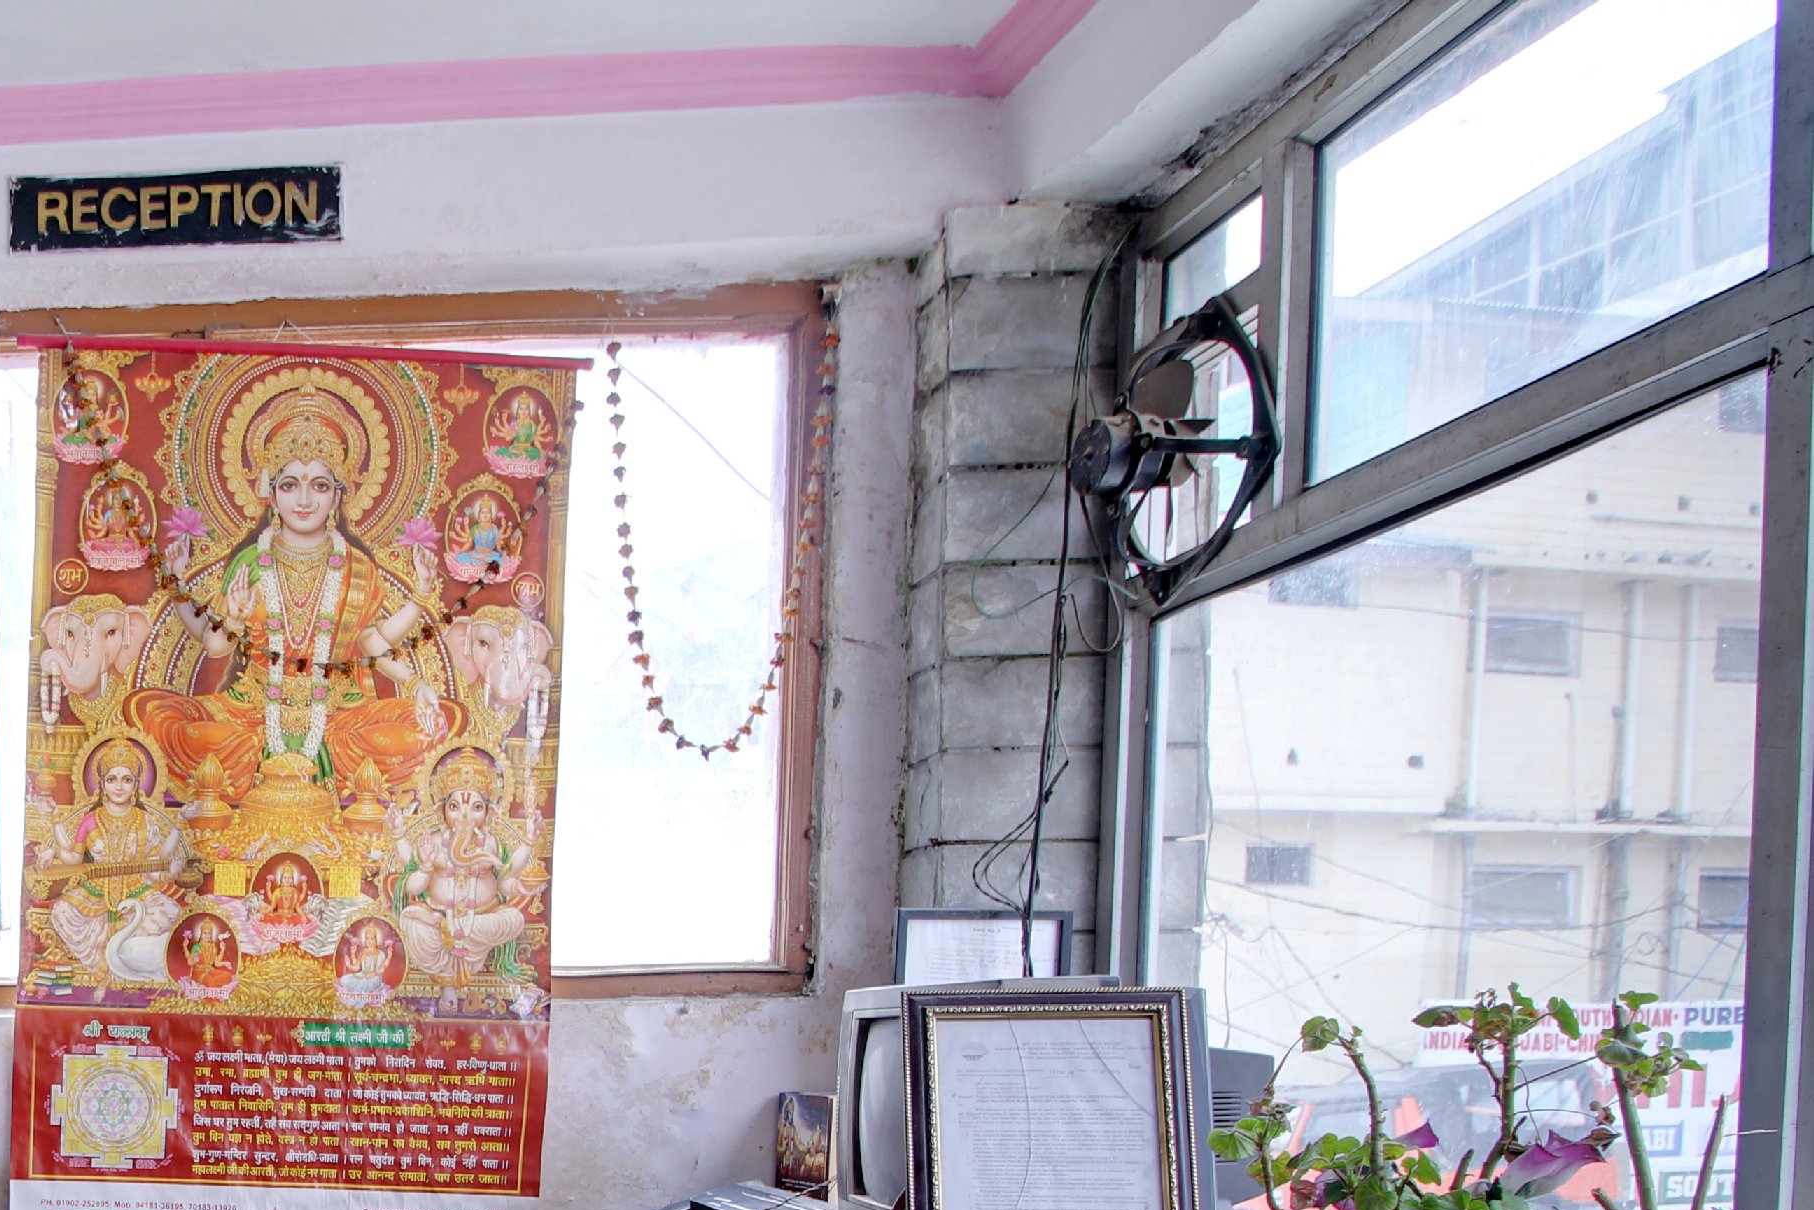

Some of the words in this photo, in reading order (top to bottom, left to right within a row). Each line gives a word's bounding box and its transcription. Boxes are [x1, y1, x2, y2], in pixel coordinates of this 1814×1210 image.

[37, 180, 318, 236] RECEPTION
[59, 568, 83, 588] शुभ
[82, 1019, 103, 1038] श्री
[305, 1027, 331, 1043] आरती
[335, 1027, 347, 1043] श्री
[376, 1029, 388, 1044] जी
[391, 1029, 405, 1044] की
